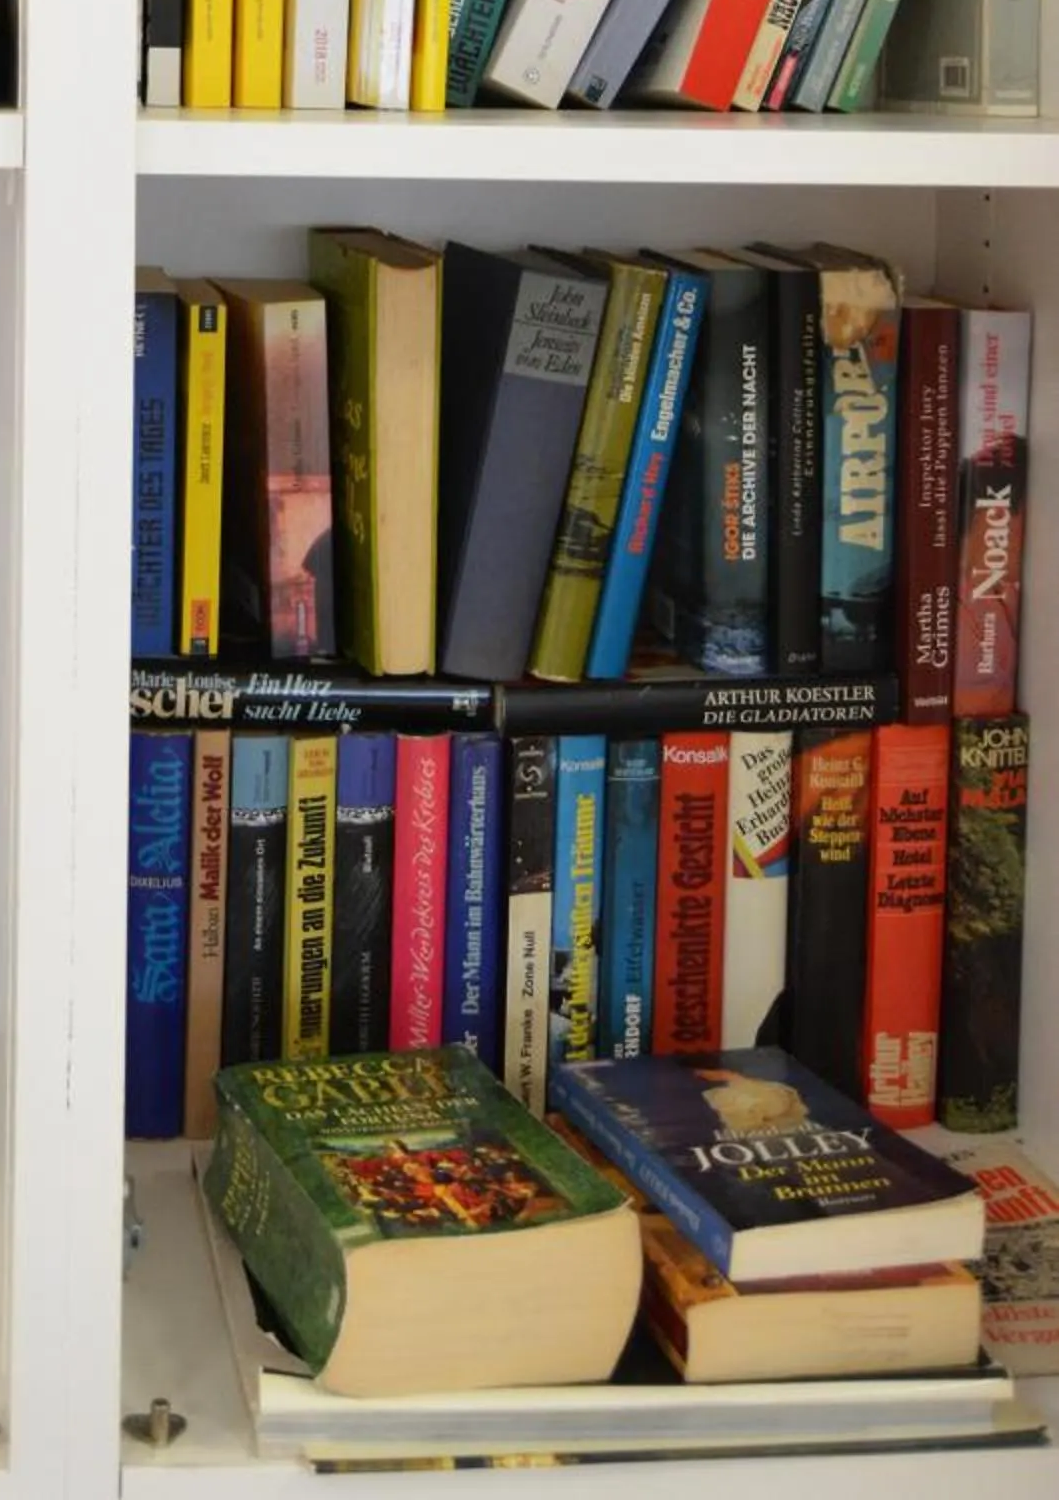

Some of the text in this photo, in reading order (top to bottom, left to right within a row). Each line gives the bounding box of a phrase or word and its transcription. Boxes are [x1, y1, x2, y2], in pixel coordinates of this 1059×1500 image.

[544, 354, 582, 375] Eden
[650, 288, 698, 442] Engelmacher & Co.
[979, 333, 998, 420] sind einer
[143, 398, 165, 465] TAGES
[741, 345, 758, 561] DIE ARCHIVE DER NACHT
[832, 346, 888, 550] AIRPOR
[918, 384, 934, 508] Inspektor Jury
[933, 344, 952, 493] die Puppen tanzen
[723, 510, 739, 561] IGOR
[970, 483, 1013, 674] Barbara Noack
[916, 593, 934, 664] Martha
[932, 586, 951, 669] Grimes
[242, 702, 362, 721] sucht Liebe
[246, 674, 333, 697] Ein Herz
[702, 706, 875, 724] DIE GLADIATOREN
[704, 685, 875, 707] ARTHUR KOESTLER
[741, 742, 776, 773] Das
[977, 726, 1028, 748] JOHN
[200, 755, 223, 900] Malik der Wolf
[837, 814, 860, 828] der
[899, 789, 927, 806] Auf
[298, 796, 326, 932] an die Zukunft
[570, 794, 595, 877] Träume
[820, 847, 851, 862] wind
[891, 849, 933, 866] Hotel
[462, 765, 487, 1015] Der Mann im Bahnwärterhaus
[669, 792, 715, 1042] geschenkte Gesicht
[521, 931, 535, 1058] Franke Zone Null
[868, 1032, 900, 1105] Arthur
[902, 1031, 935, 1105] Hailey
[688, 1127, 873, 1173] JOLLEY
[739, 1156, 875, 1181] Der Mann
[803, 1174, 839, 1185] im
[774, 1178, 891, 1199] Brunnen
